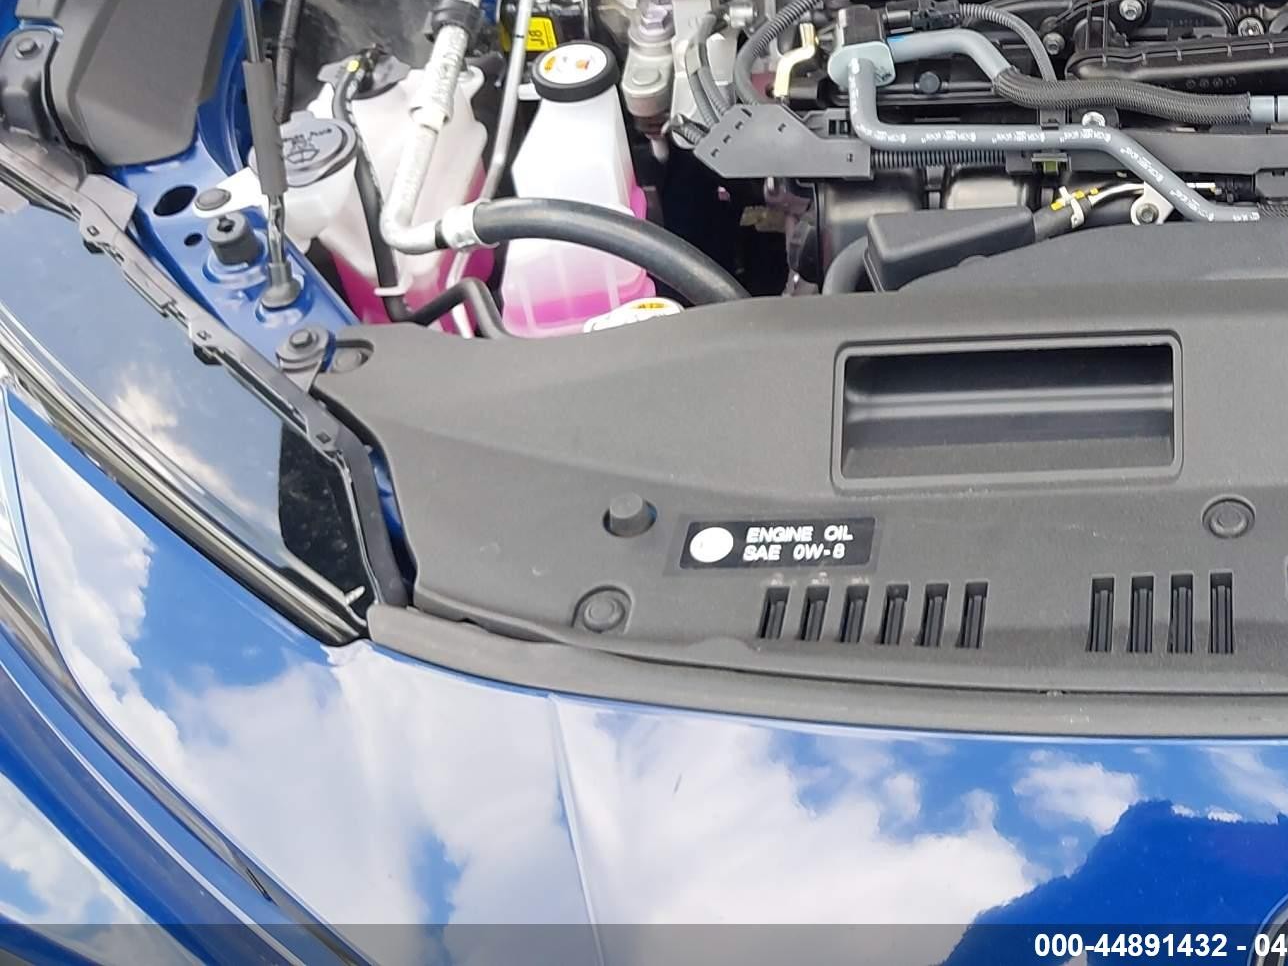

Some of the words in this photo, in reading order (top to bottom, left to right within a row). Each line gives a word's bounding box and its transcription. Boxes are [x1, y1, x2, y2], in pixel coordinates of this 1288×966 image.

[746, 526, 813, 543] ENGINE
[824, 525, 853, 542] OIL
[743, 544, 782, 561] SAE
[793, 543, 846, 560] 0W-8
